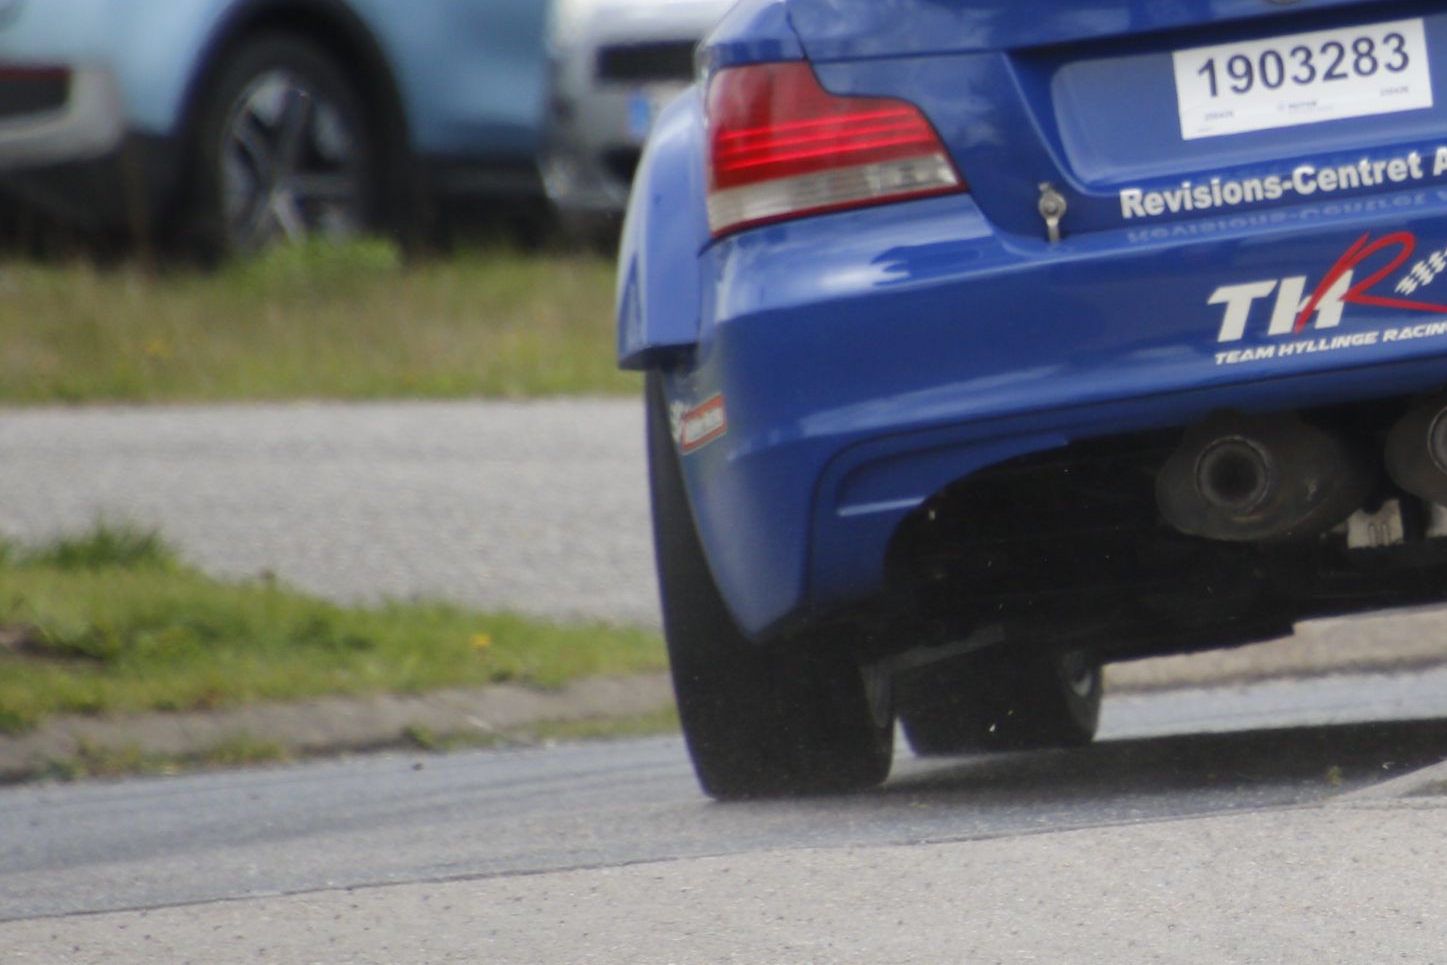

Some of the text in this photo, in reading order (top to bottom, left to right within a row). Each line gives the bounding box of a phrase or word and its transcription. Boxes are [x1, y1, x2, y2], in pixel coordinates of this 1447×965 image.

[1197, 31, 1411, 98] 1903283
[1119, 150, 1423, 219] Revisions-Centret
[1215, 346, 1275, 365] TEAM
[1278, 331, 1379, 357] HYLLINGE
